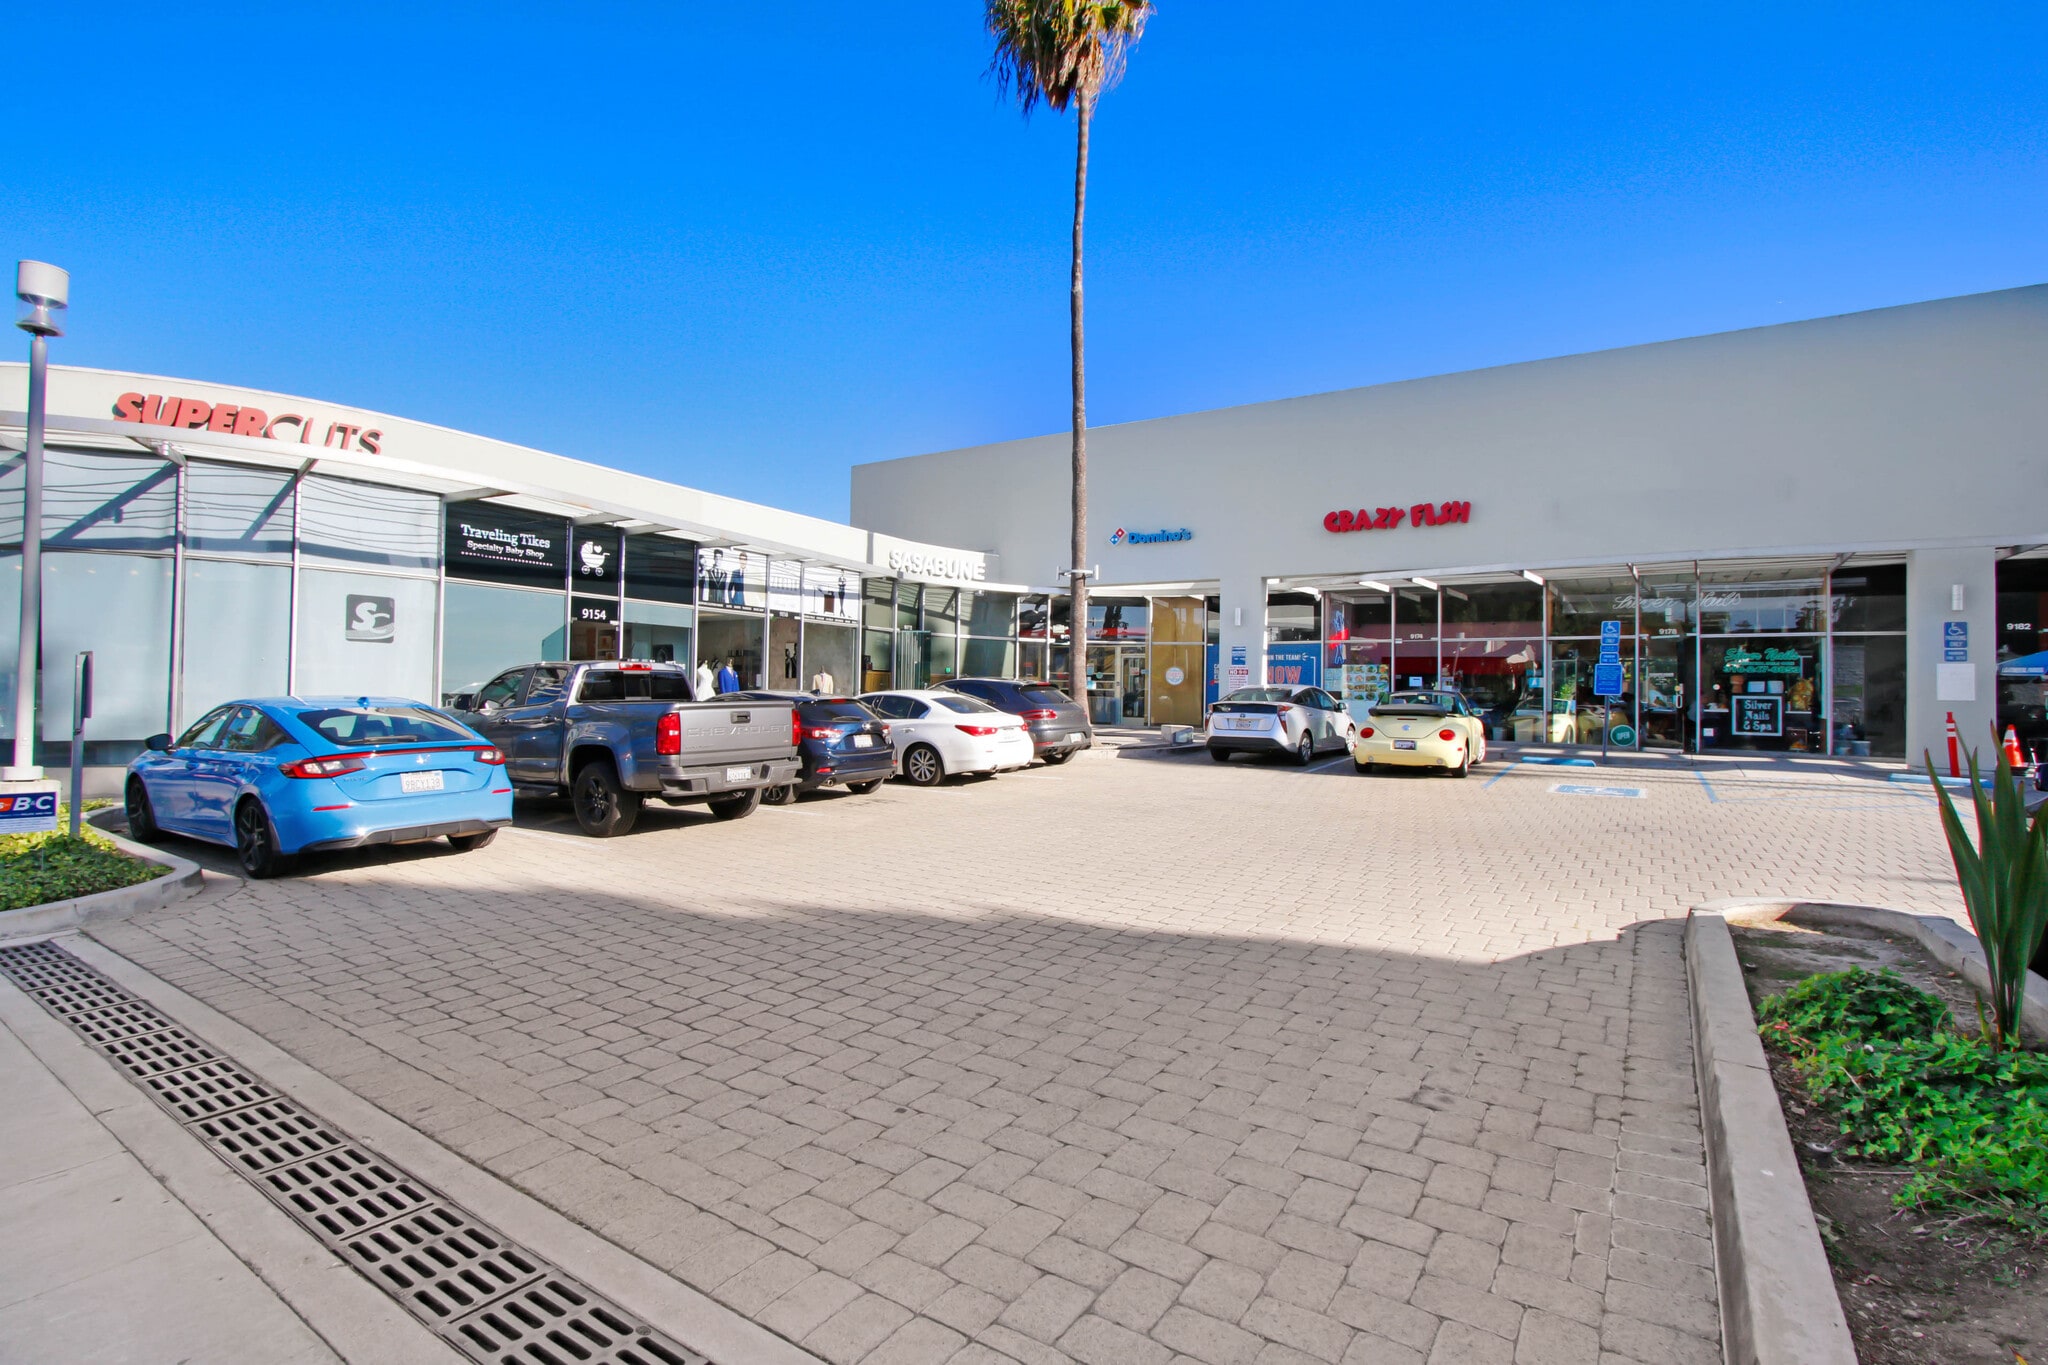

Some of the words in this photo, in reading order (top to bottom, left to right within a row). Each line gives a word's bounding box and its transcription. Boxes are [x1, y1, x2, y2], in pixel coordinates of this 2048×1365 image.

[112, 391, 385, 455] SUPERCUTS
[1323, 507, 1406, 533] CRAZY
[1410, 500, 1471, 527] FISH
[460, 524, 518, 547] Traveling
[520, 533, 550, 548] Tikes
[1128, 528, 1192, 544] Domino's
[467, 540, 503, 553] Specialty
[505, 545, 524, 557] Baby
[525, 549, 544, 559] Shop
[889, 550, 985, 580] SASABUNE
[582, 608, 606, 620] 9154
[1744, 700, 1772, 709] Silver
[1745, 711, 1769, 720] Nails
[688, 724, 789, 737] CHEVROLET
[1752, 721, 1772, 732] Spa
